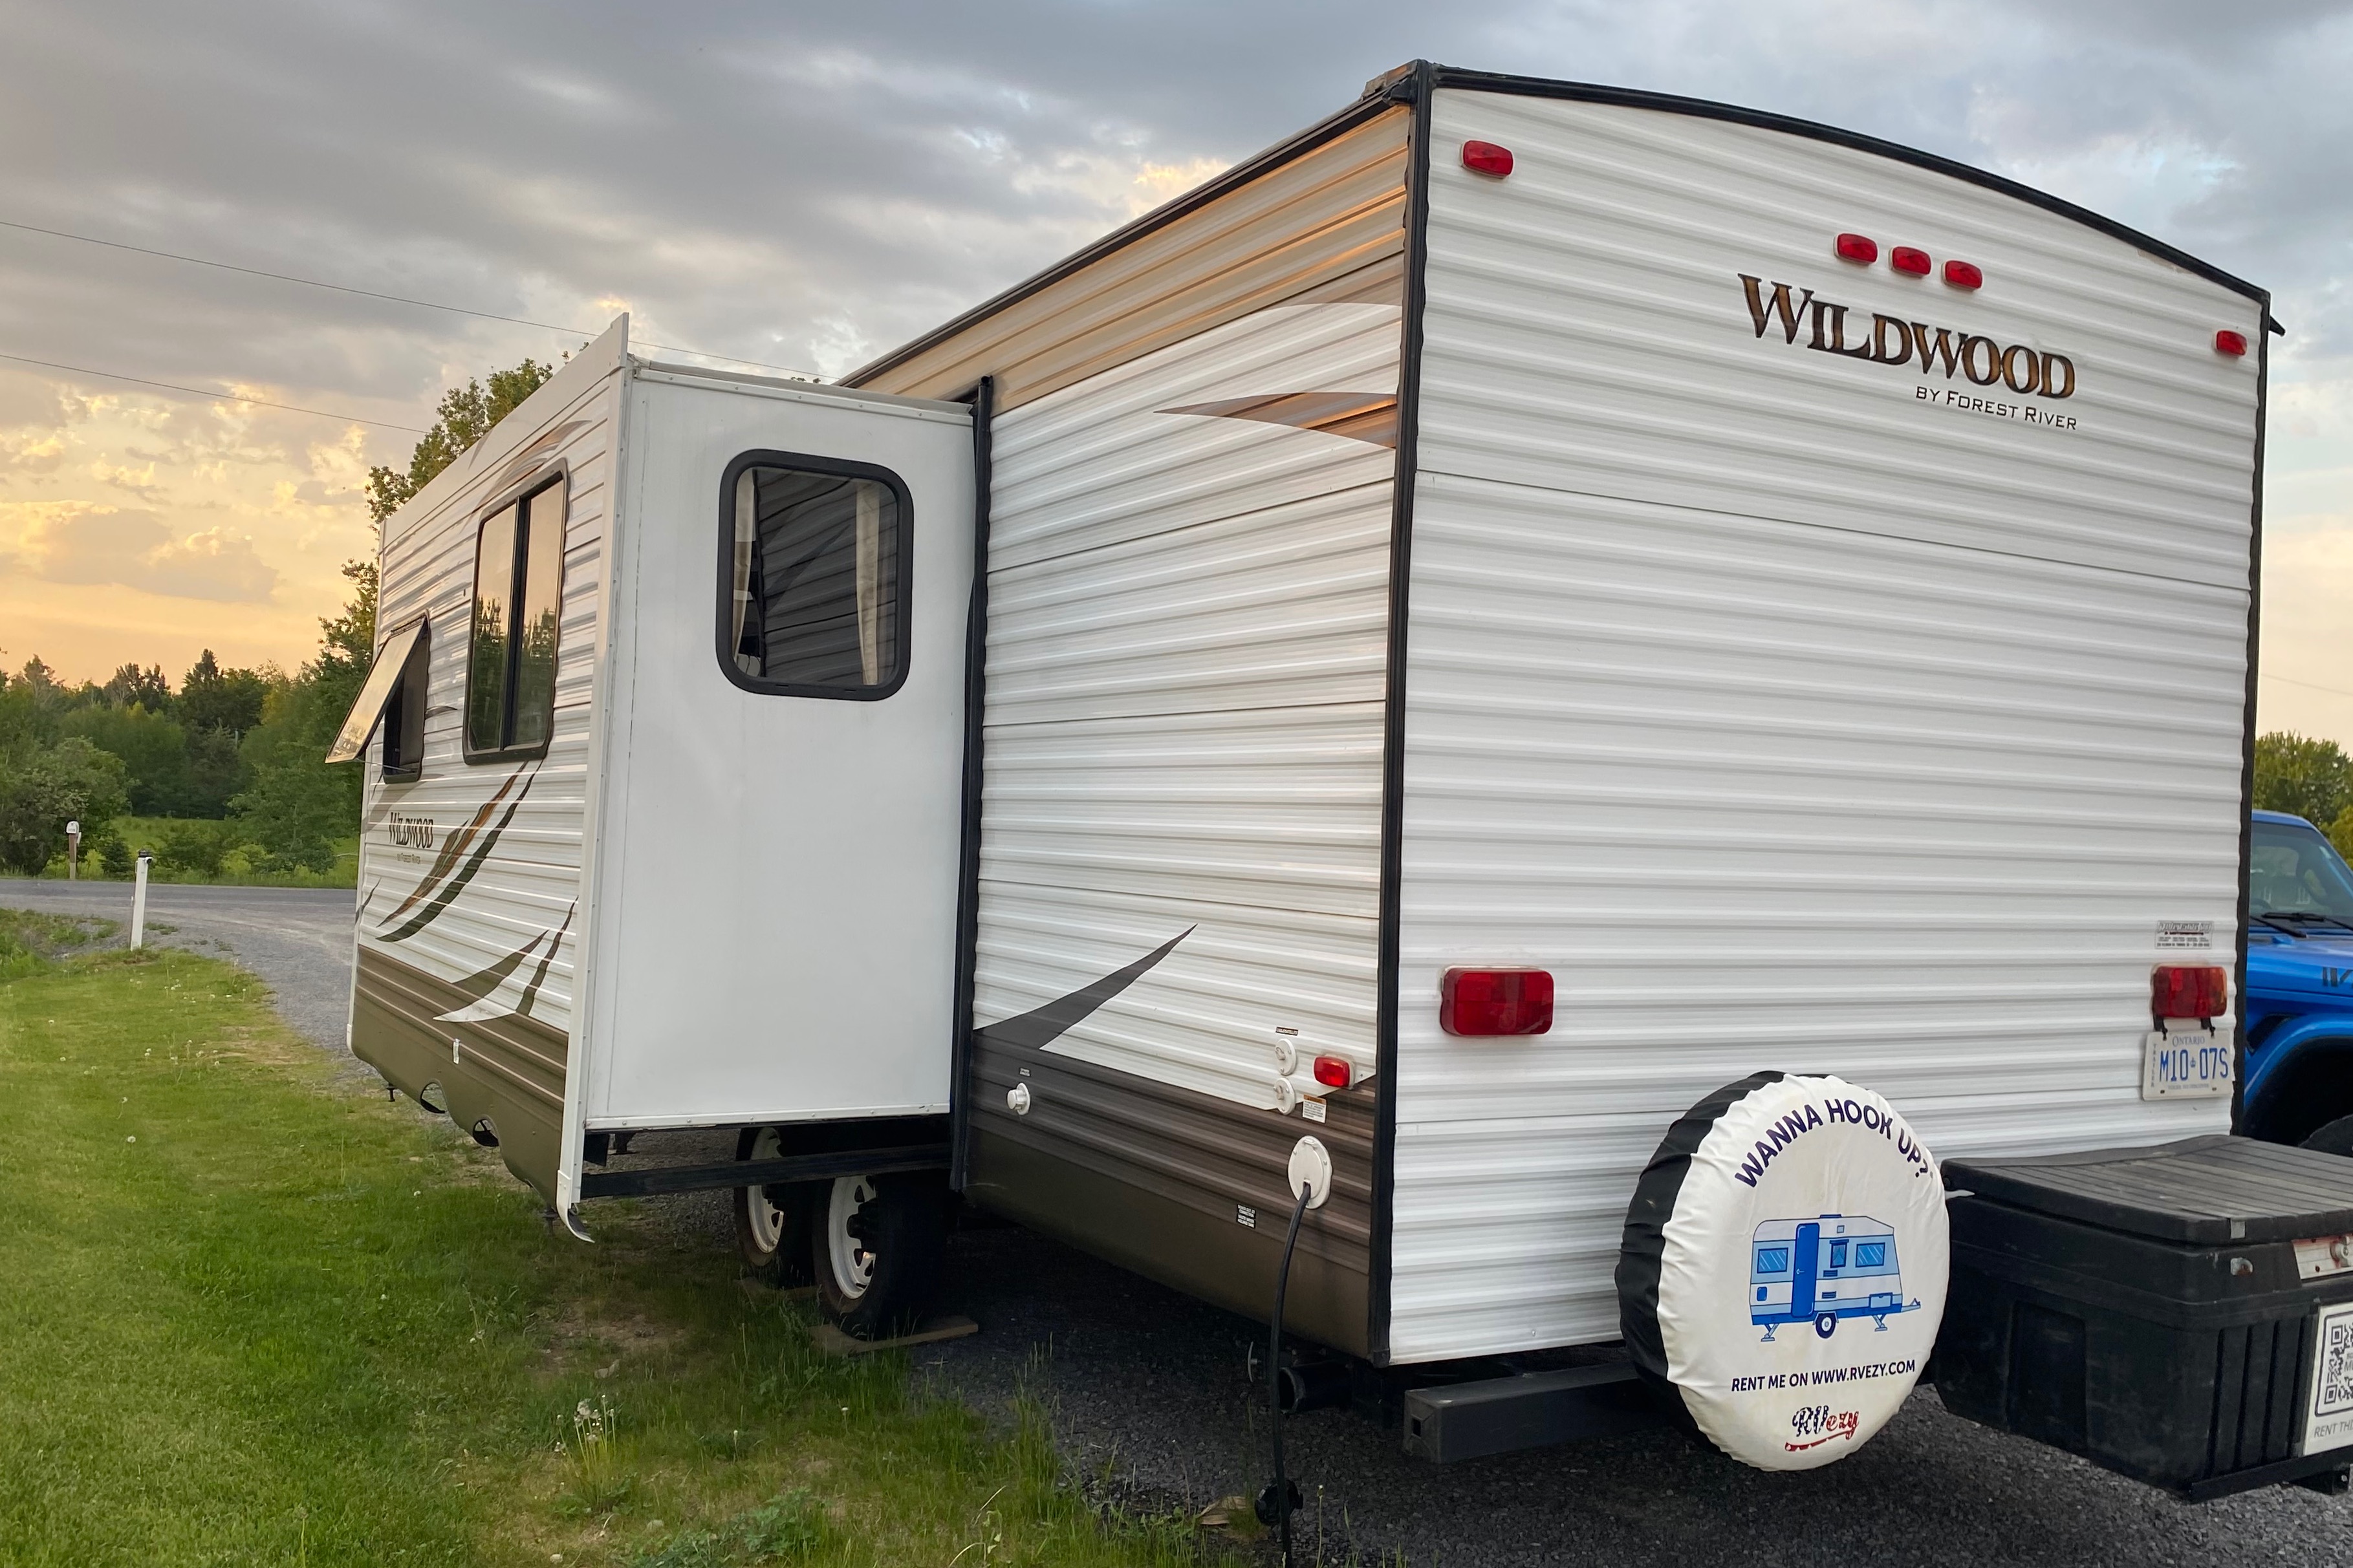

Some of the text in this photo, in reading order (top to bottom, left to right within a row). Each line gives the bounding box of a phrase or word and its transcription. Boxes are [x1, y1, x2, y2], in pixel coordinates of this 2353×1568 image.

[1737, 273, 2076, 399] WILDWOOD
[1916, 386, 2076, 430] BY FOREST RIVER
[389, 812, 434, 848] WILDWOOD
[2173, 1036, 2205, 1047] ONTARIO
[1735, 1099, 1929, 1188] WANNA HOOK UP?
[1731, 1359, 1915, 1391] RENT ME ON WWW.RVEZY.COM
[2314, 1423, 2337, 1437] RENT
